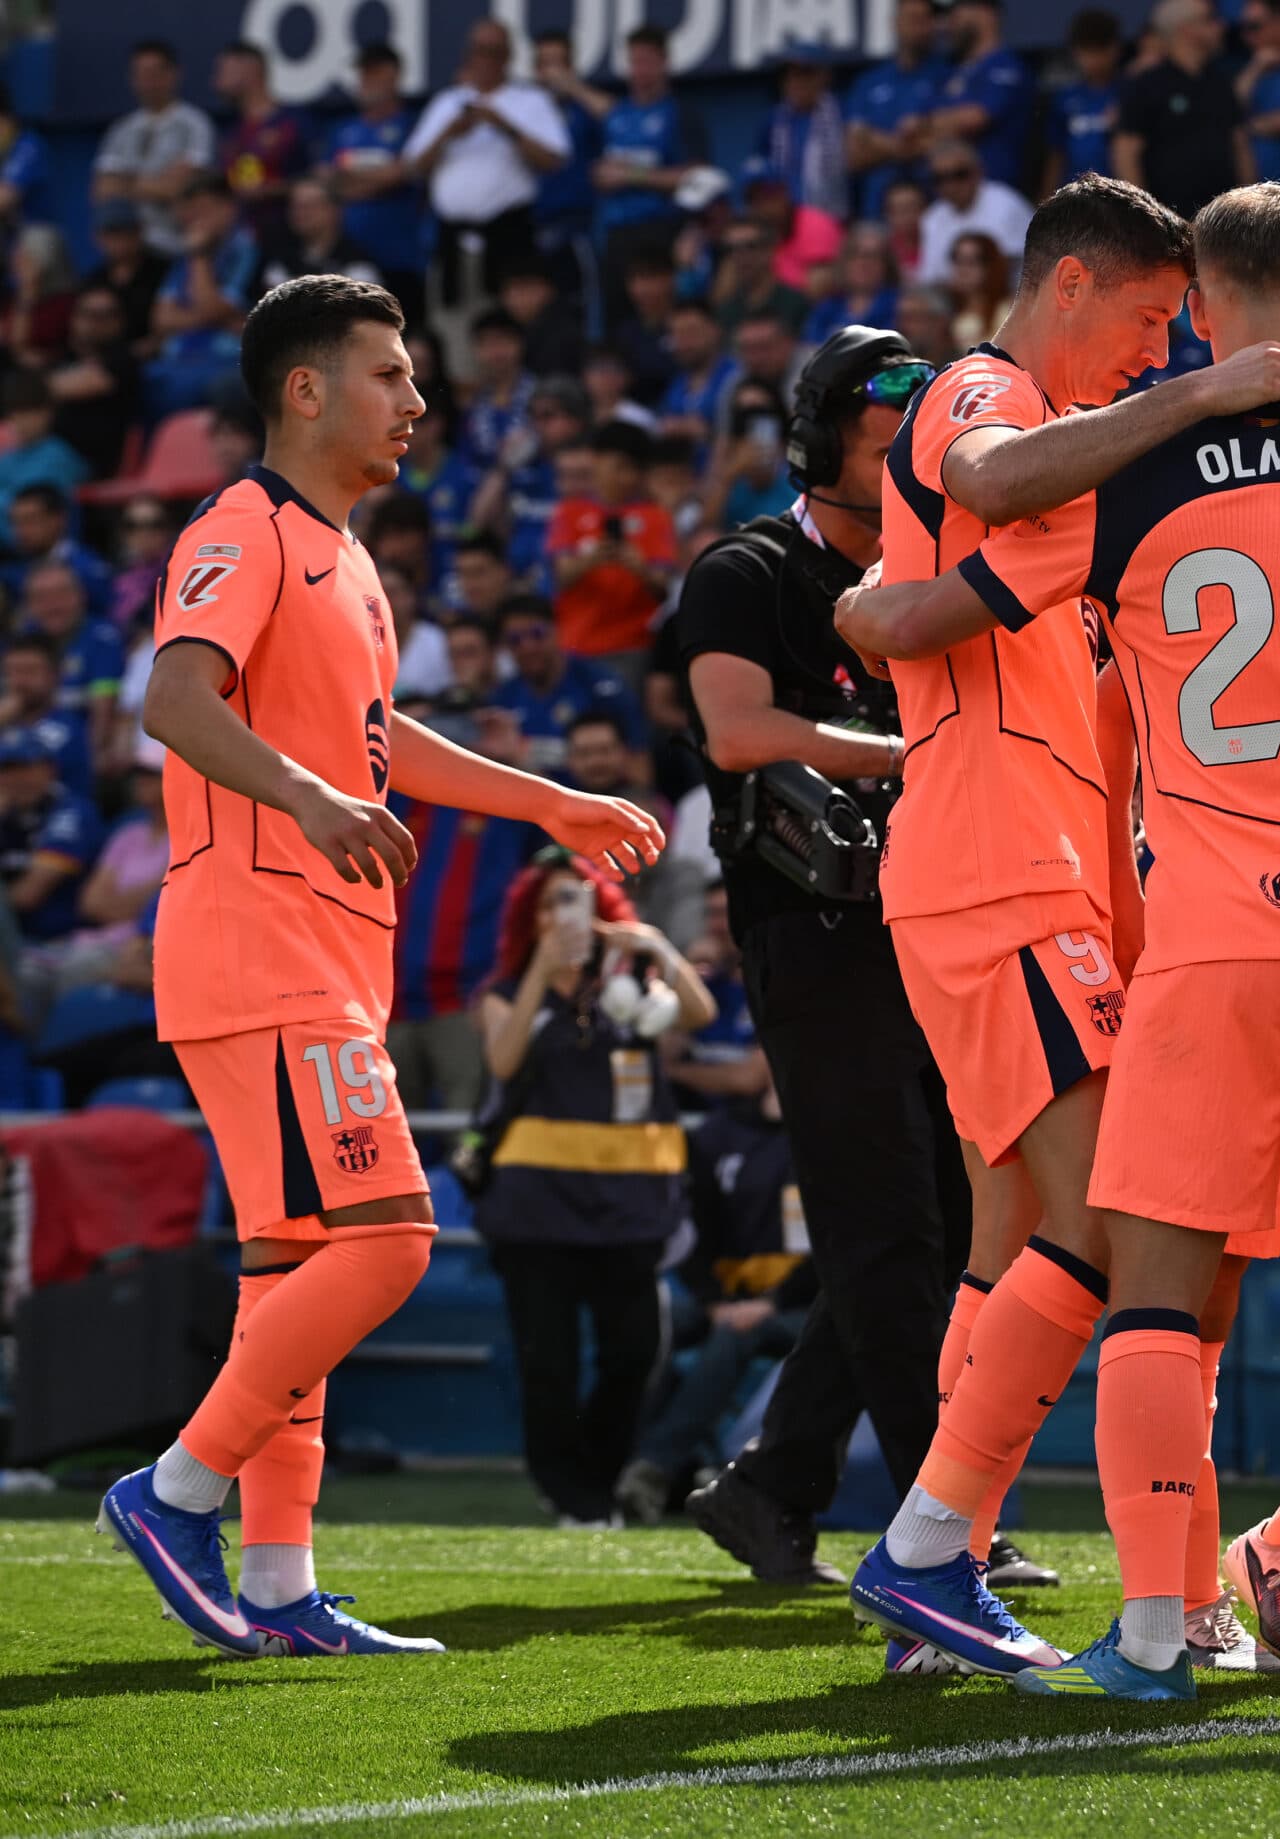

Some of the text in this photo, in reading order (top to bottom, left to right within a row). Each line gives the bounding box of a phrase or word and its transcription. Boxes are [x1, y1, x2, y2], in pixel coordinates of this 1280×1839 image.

[1054, 930, 1111, 986] 9
[301, 1038, 388, 1126] 19
[879, 1600, 903, 1616] ZOOM
